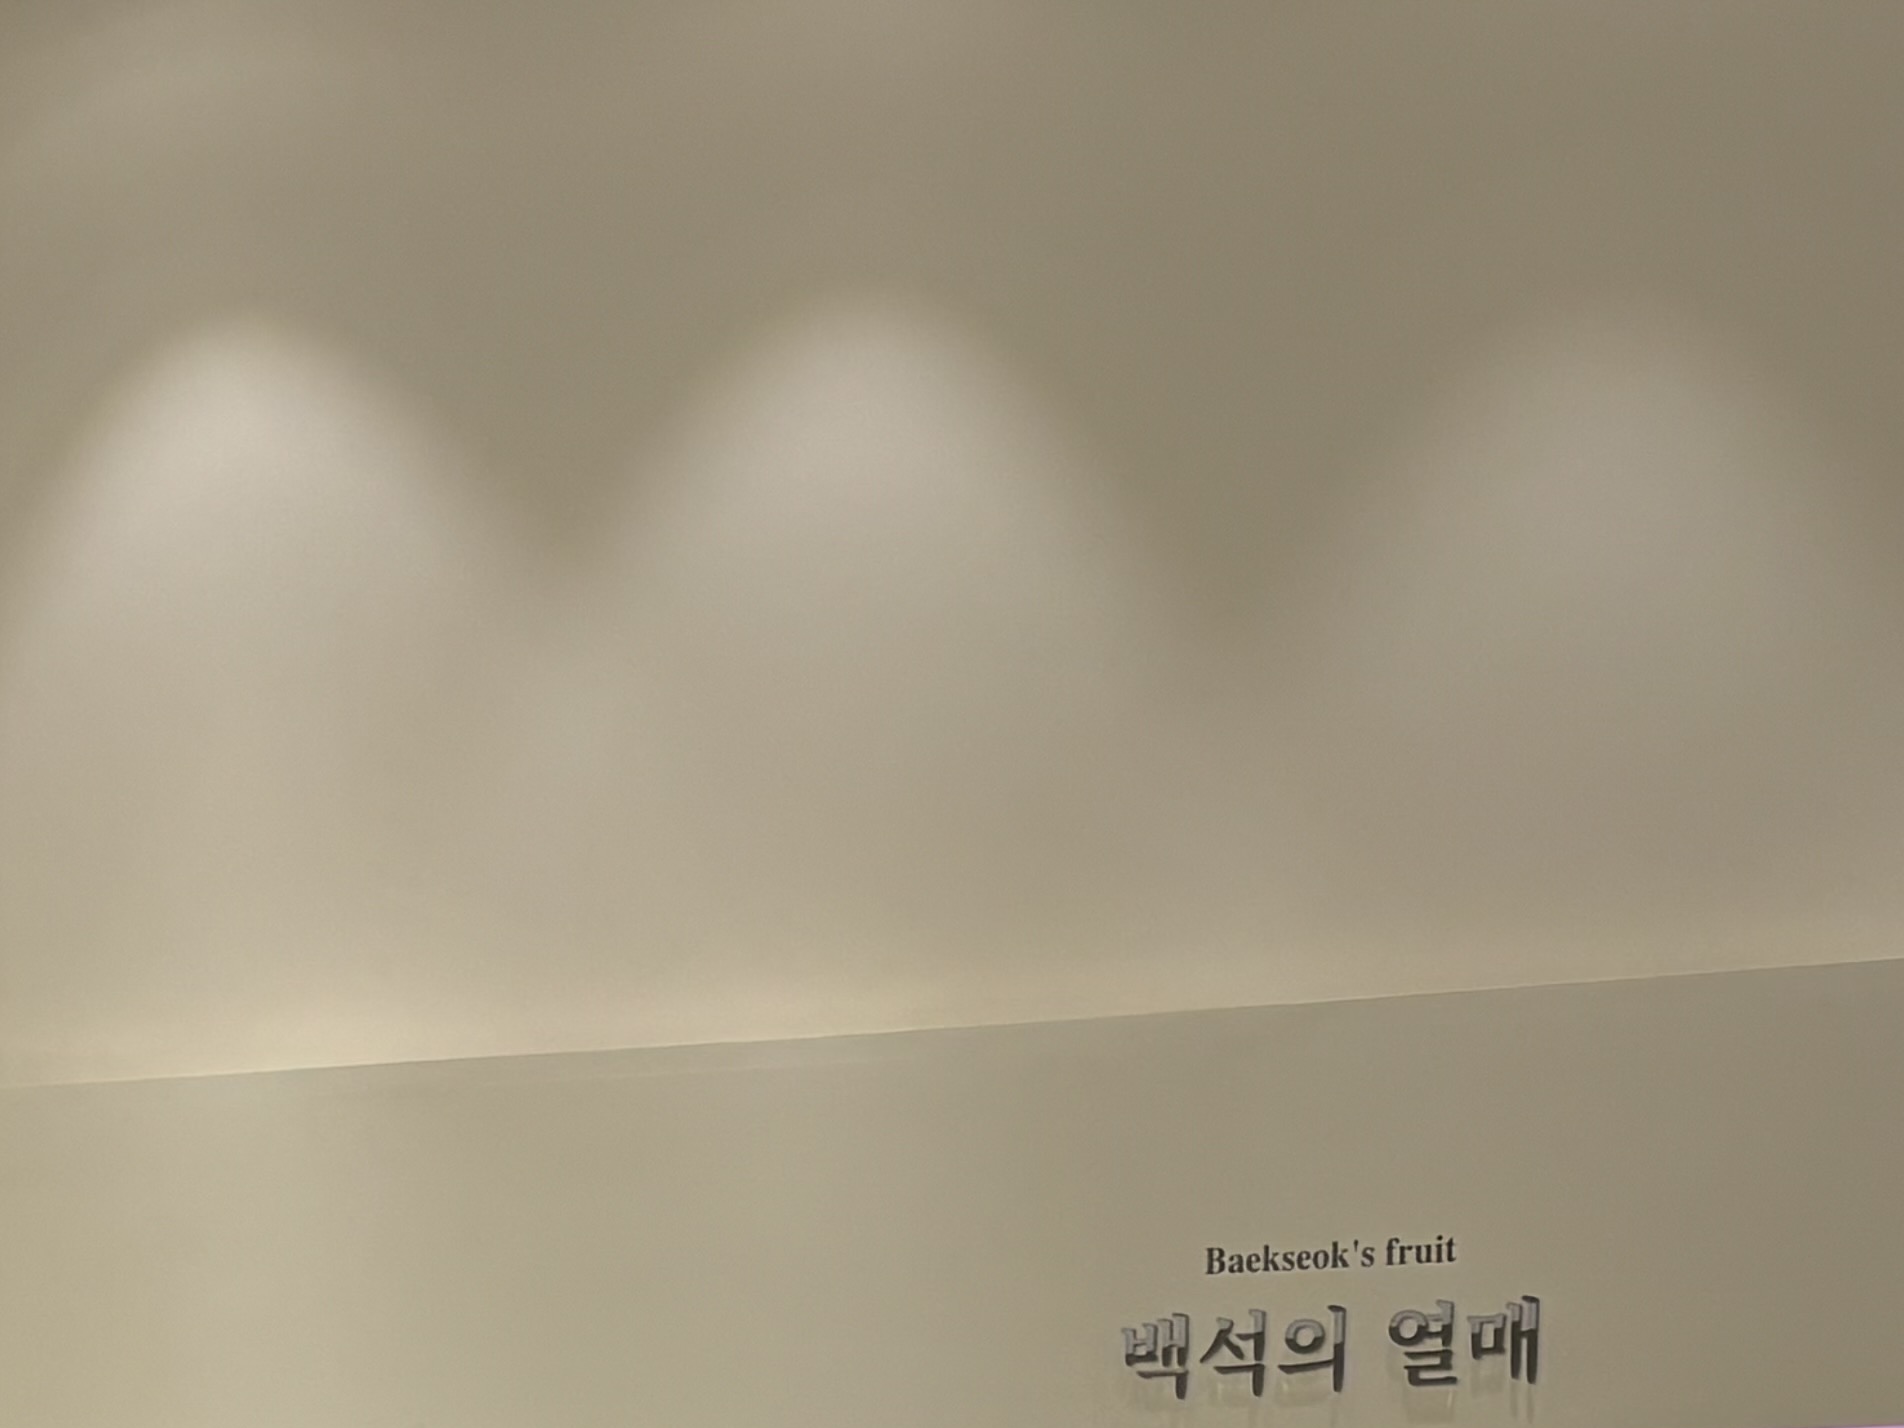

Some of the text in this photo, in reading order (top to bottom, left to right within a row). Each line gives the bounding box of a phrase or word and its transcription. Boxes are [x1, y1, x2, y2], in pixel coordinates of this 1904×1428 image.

[1205, 1235, 1458, 1275] Baekseok's fruit
[1121, 1295, 1542, 1400] 백석의 열매
